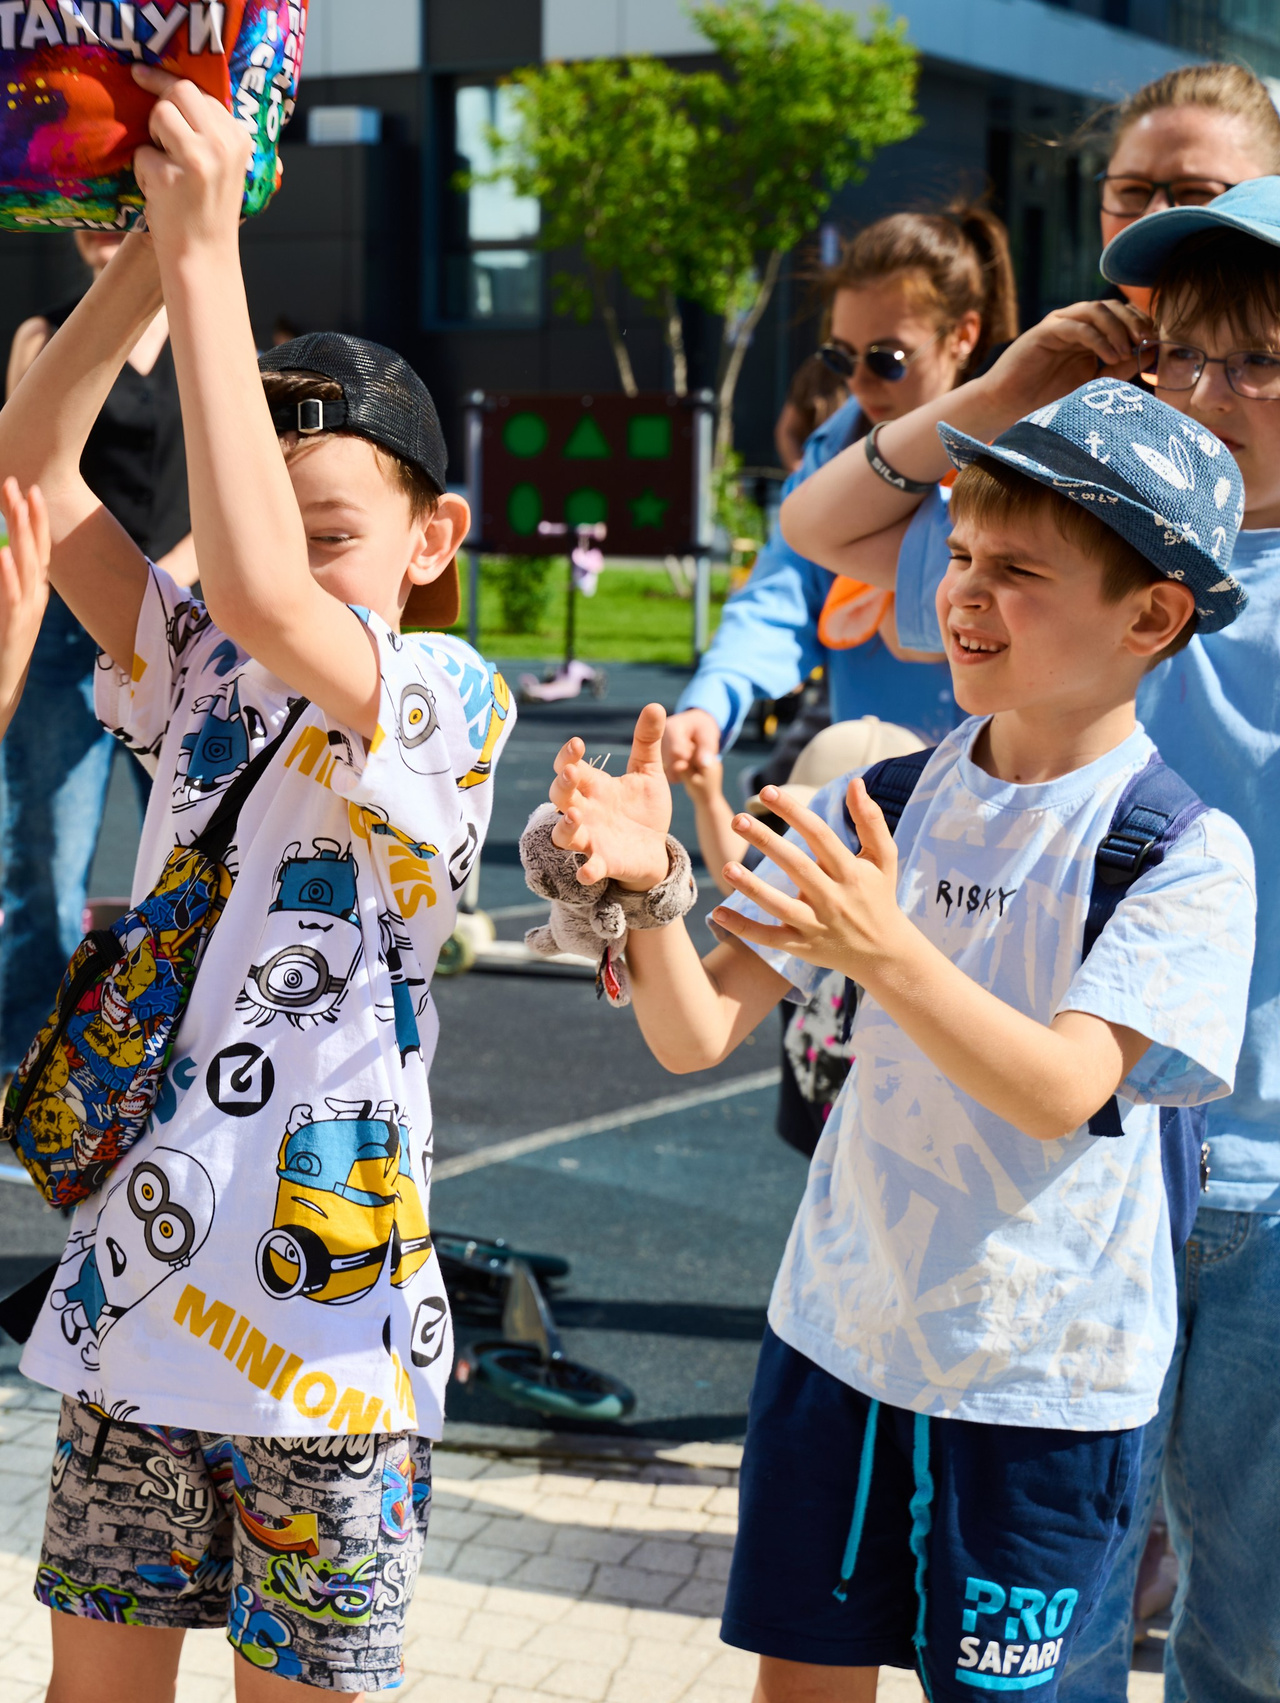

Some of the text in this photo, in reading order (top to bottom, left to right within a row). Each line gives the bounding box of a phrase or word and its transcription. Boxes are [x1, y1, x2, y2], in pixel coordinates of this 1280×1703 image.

[267, 0, 301, 142] ЕСНЮ
[936, 880, 1017, 918] RISKY
[173, 1283, 391, 1435] MINION
[962, 1577, 1079, 1641] PRO
[957, 1636, 1064, 1675] SAFARI
